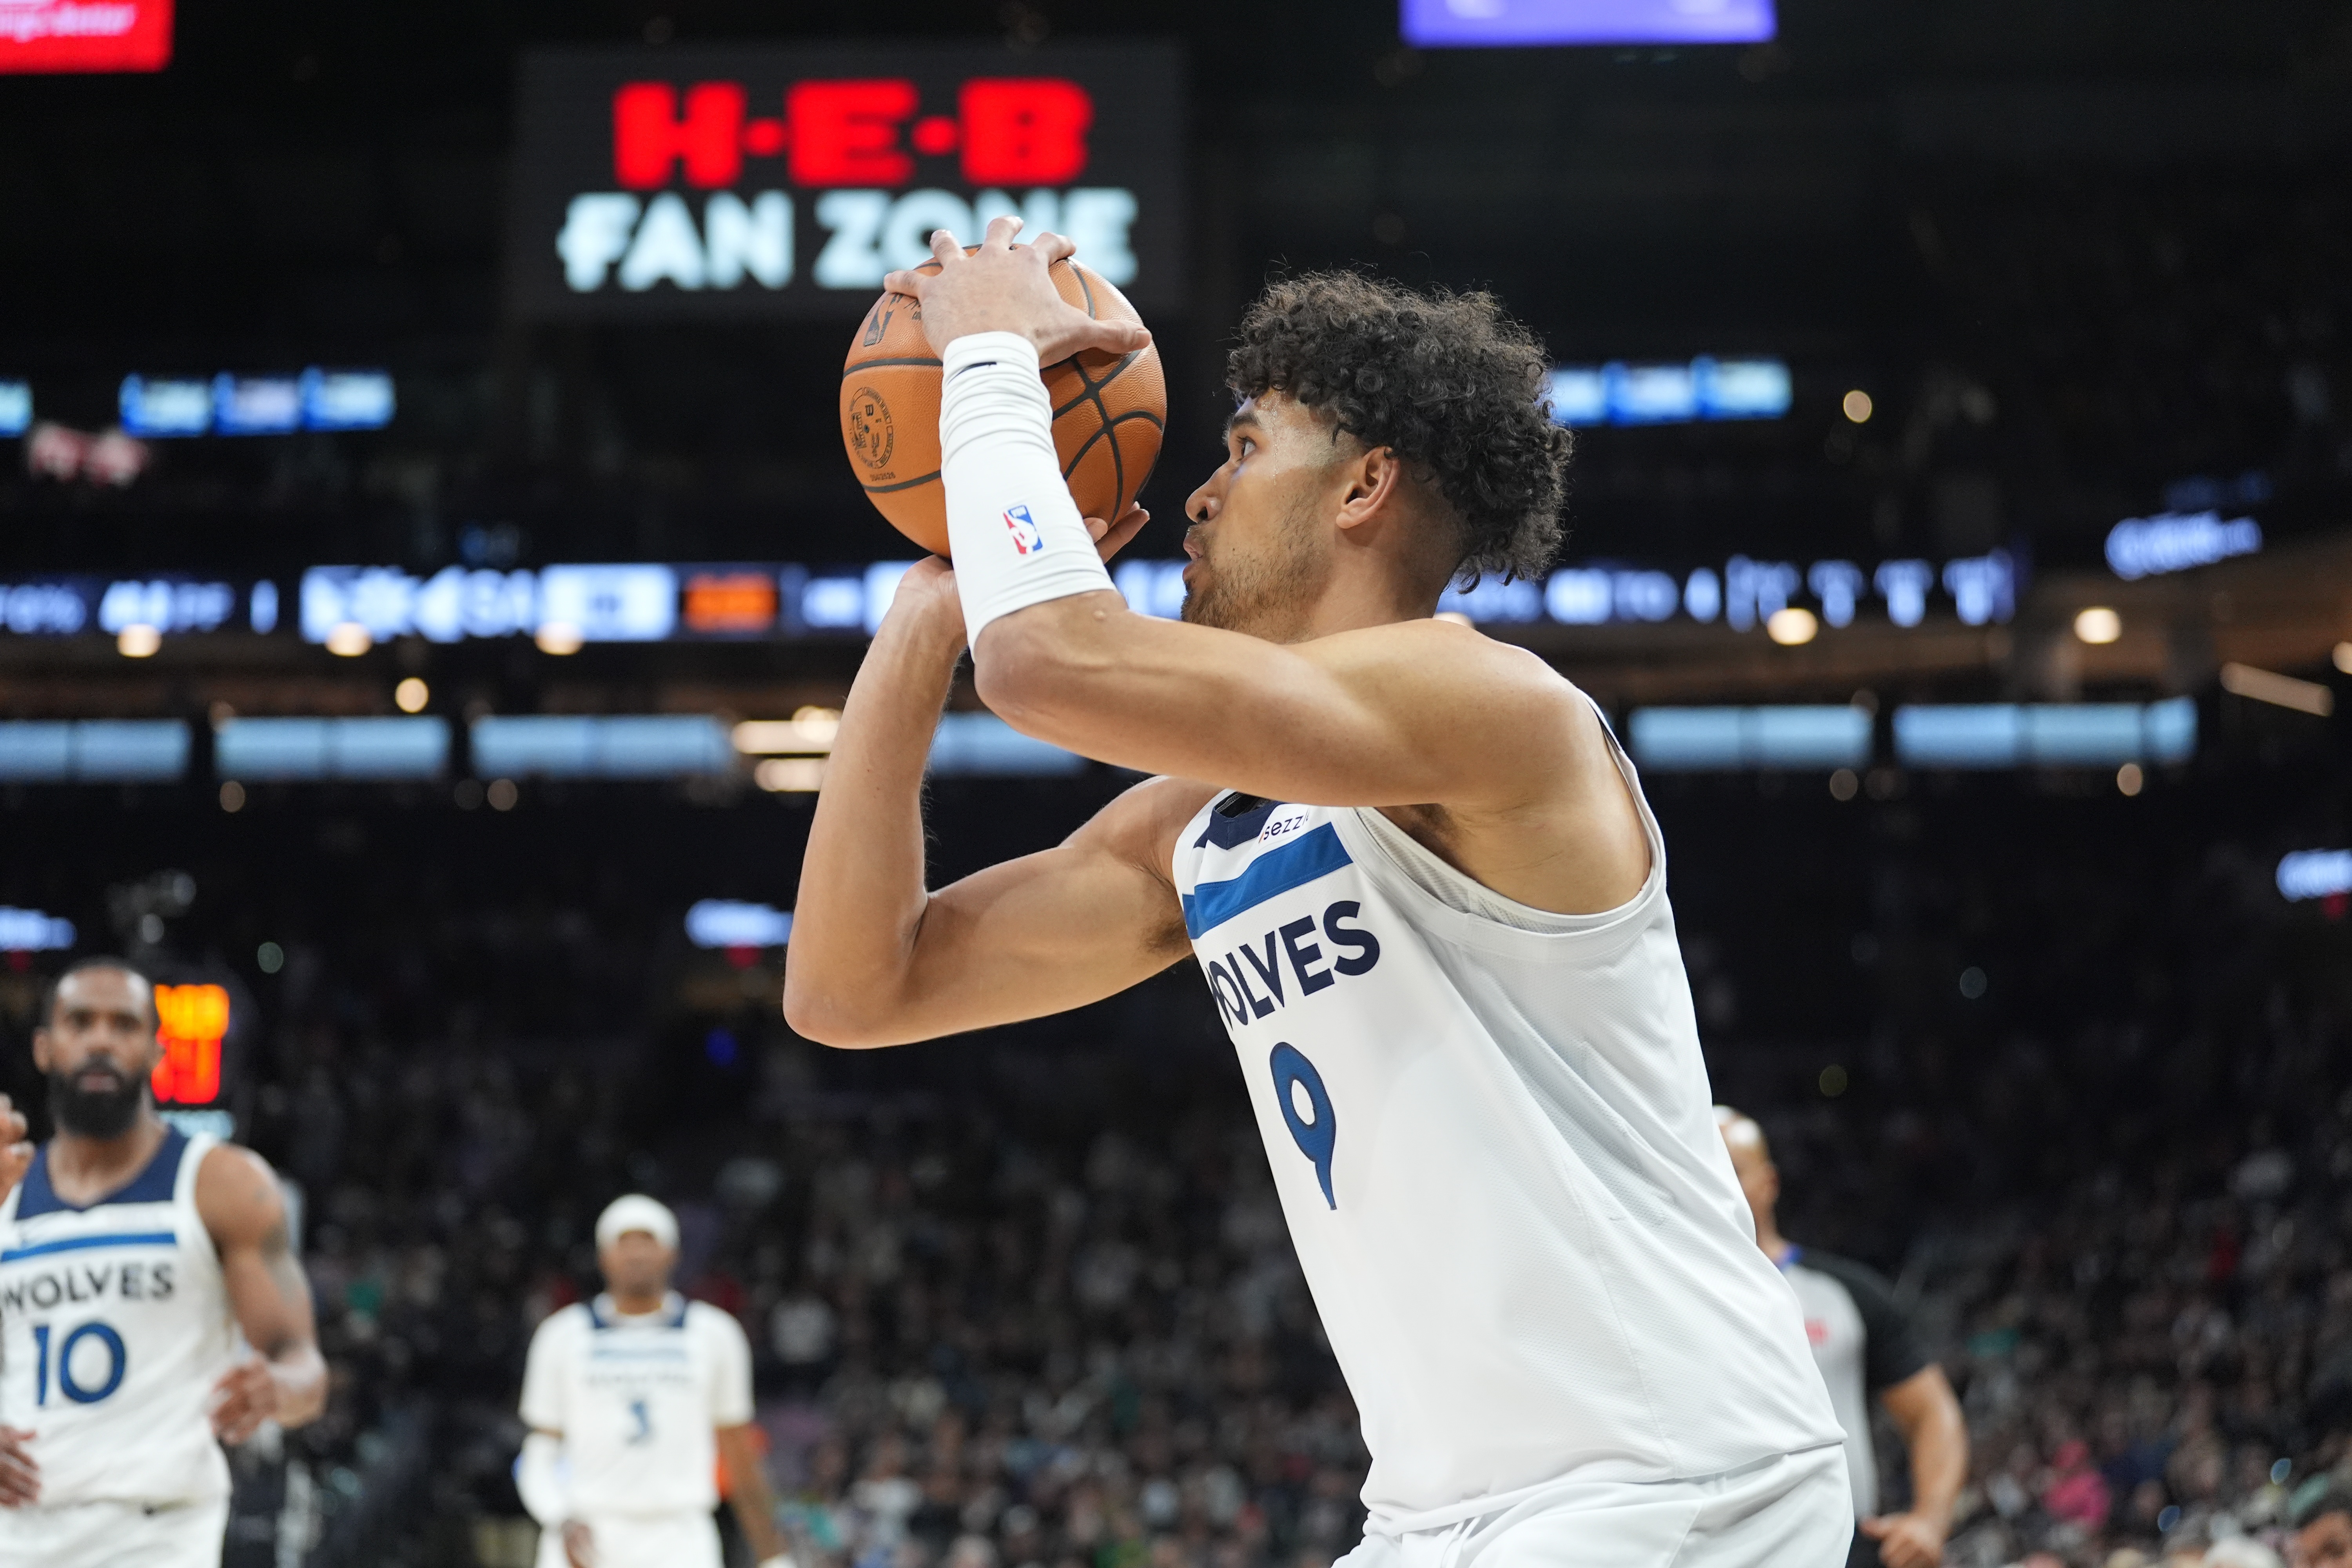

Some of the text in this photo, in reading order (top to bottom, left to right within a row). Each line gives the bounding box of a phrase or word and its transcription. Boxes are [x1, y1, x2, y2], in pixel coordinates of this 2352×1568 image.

[557, 191, 794, 291] FAN
[1269, 1042, 1337, 1210] 9
[34, 1321, 126, 1405] 10
